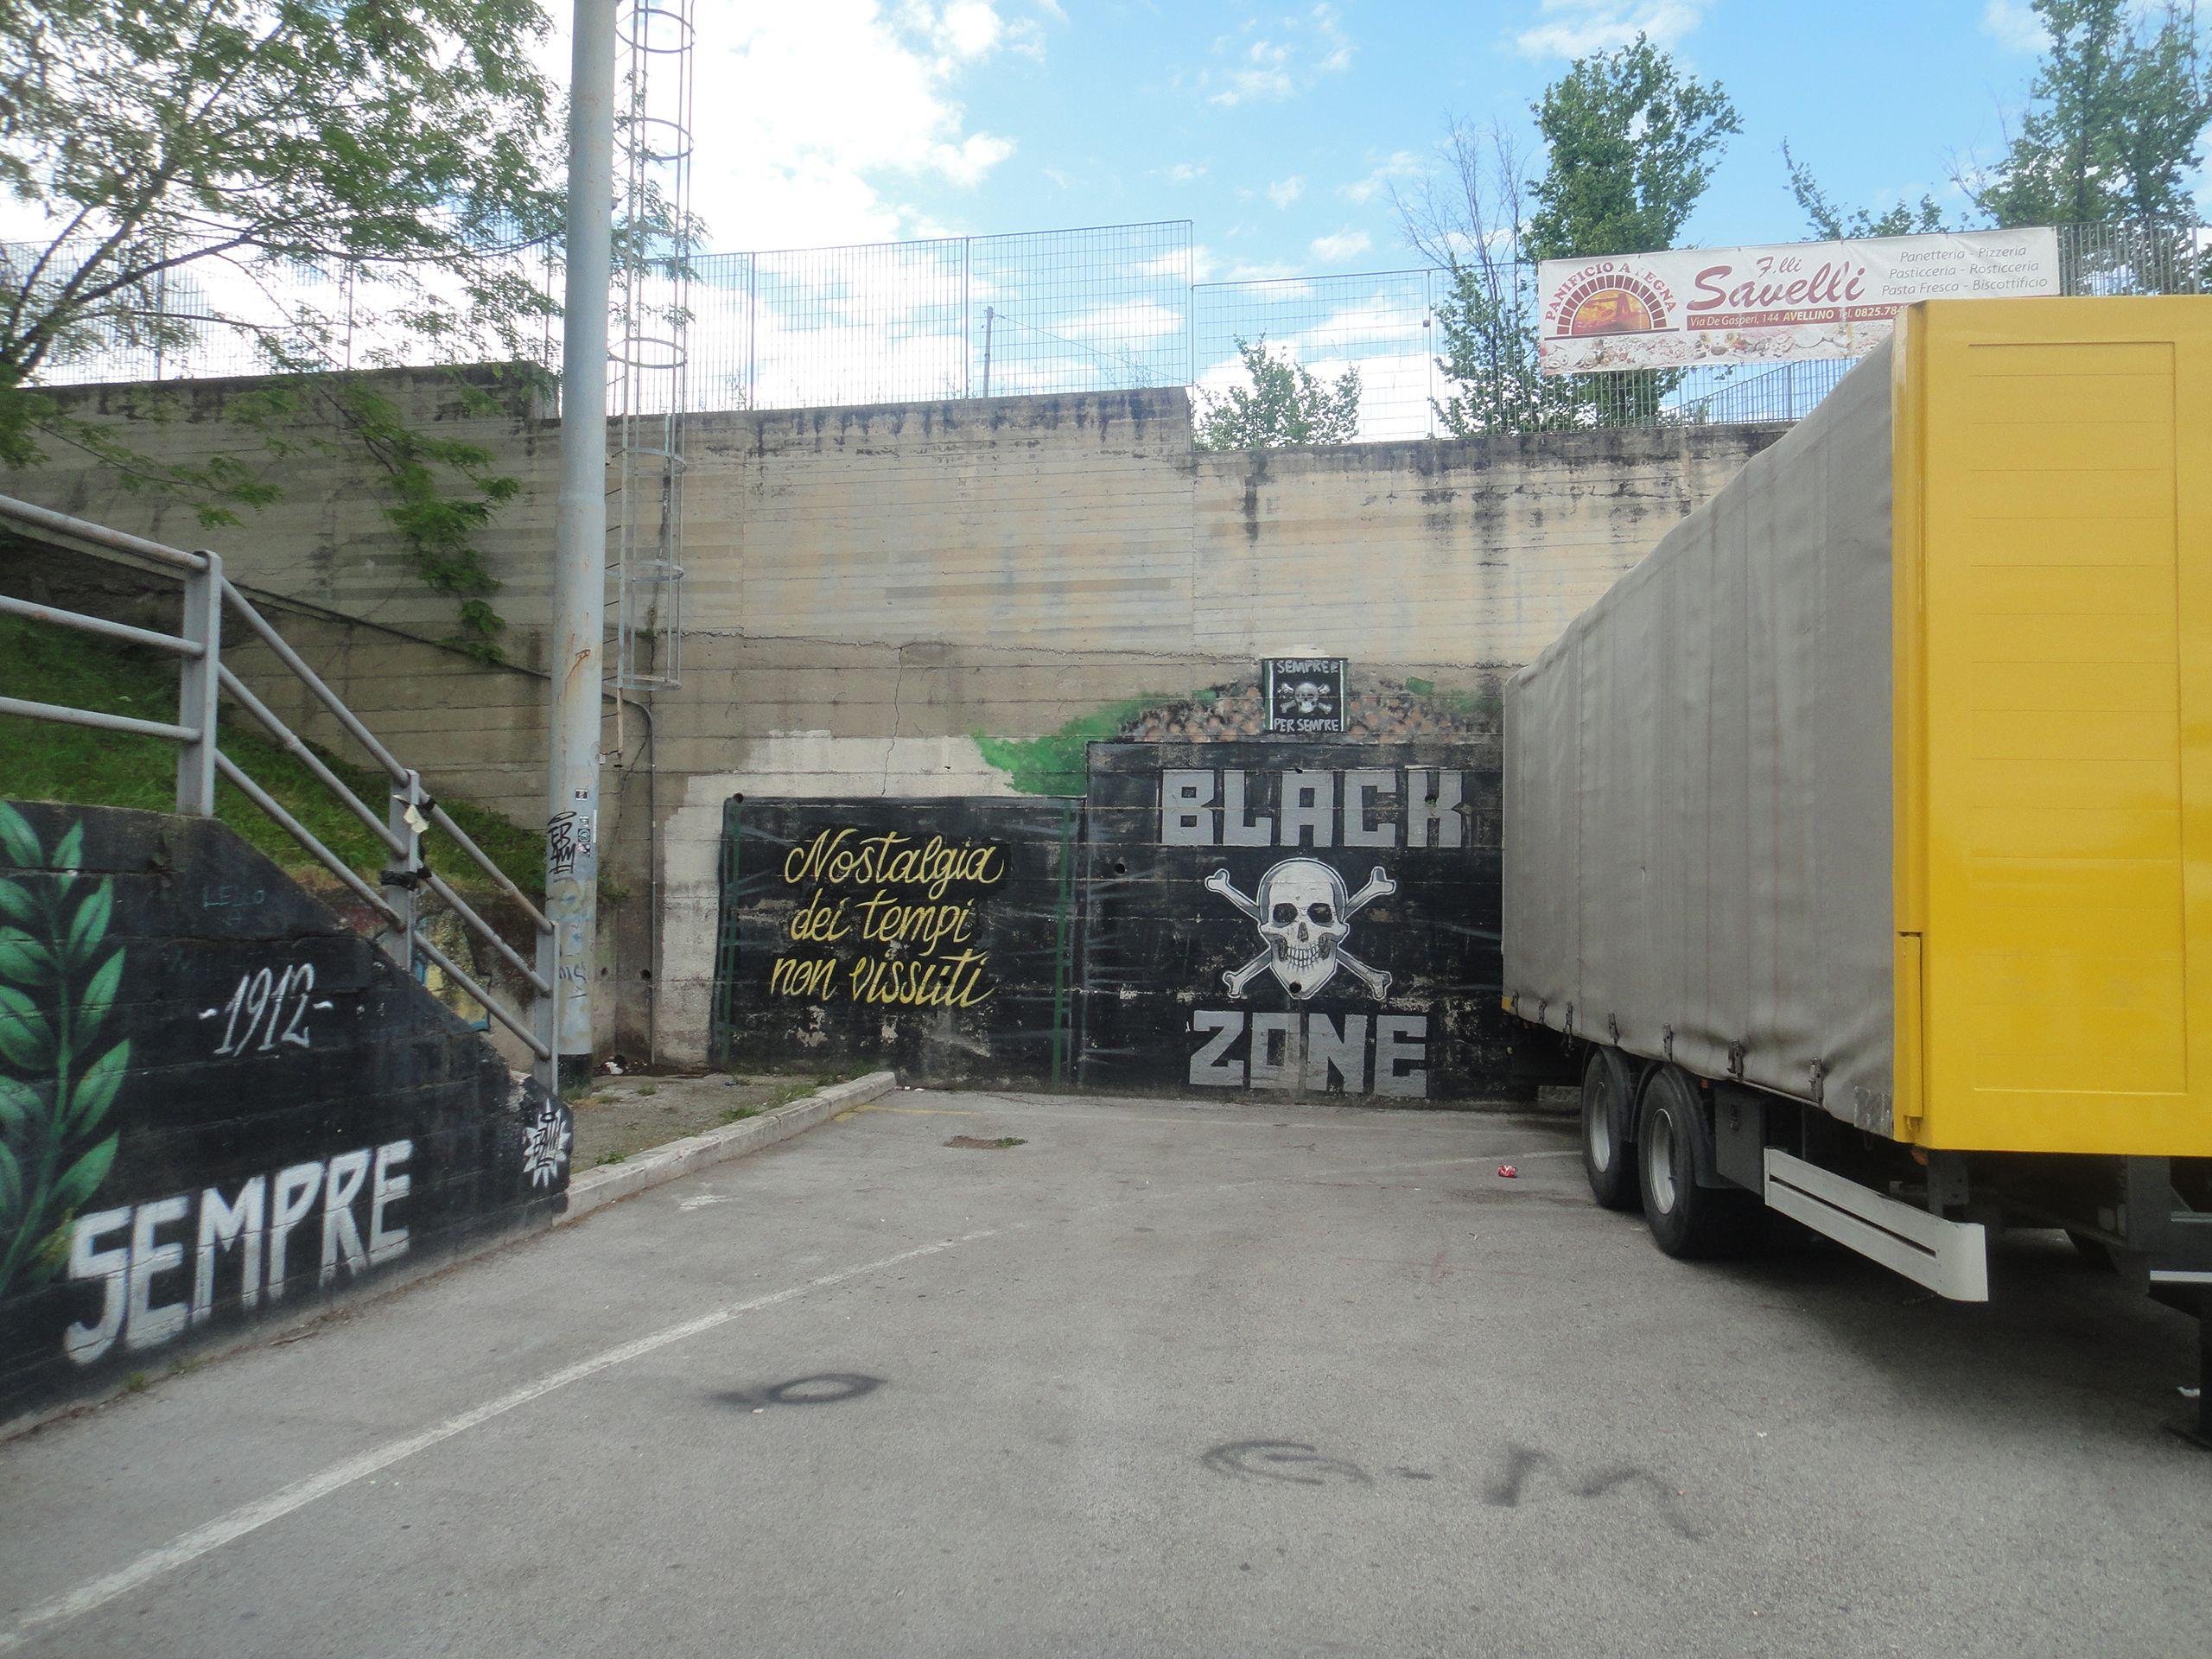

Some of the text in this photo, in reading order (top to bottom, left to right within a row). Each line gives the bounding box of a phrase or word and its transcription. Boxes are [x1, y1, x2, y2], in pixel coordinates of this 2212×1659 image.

[1756, 256, 1802, 278] F.lli
[1889, 264, 1956, 279] Pasticceria
[1969, 262, 2039, 275] Rosticceria
[1900, 248, 1965, 263] Panetteria
[1977, 246, 2026, 258] Pizzeria
[1545, 262, 1677, 321] PANIFICIO A EGNA
[1687, 261, 1866, 311] Savelli
[1882, 283, 1916, 296] Pasta
[1919, 282, 1959, 294] Fresca
[1972, 276, 2048, 291] Biscottificio
[1690, 316, 1706, 327] Via
[1707, 315, 1719, 327] De
[1721, 314, 1760, 327] Gasperi,
[1762, 313, 1779, 322] 144
[1783, 309, 1834, 322] AVELLINO
[1276, 659, 1329, 674] SEMPRE
[1274, 717, 1339, 732] PER SEMPRE
[1161, 767, 1463, 848] BLACK
[785, 828, 1004, 901] Nostalgia
[790, 887, 975, 957] dei tempi
[770, 949, 996, 1008] non vissuti
[1189, 1010, 1428, 1099] ZONE
[64, 1140, 414, 1366] SEMPRE
